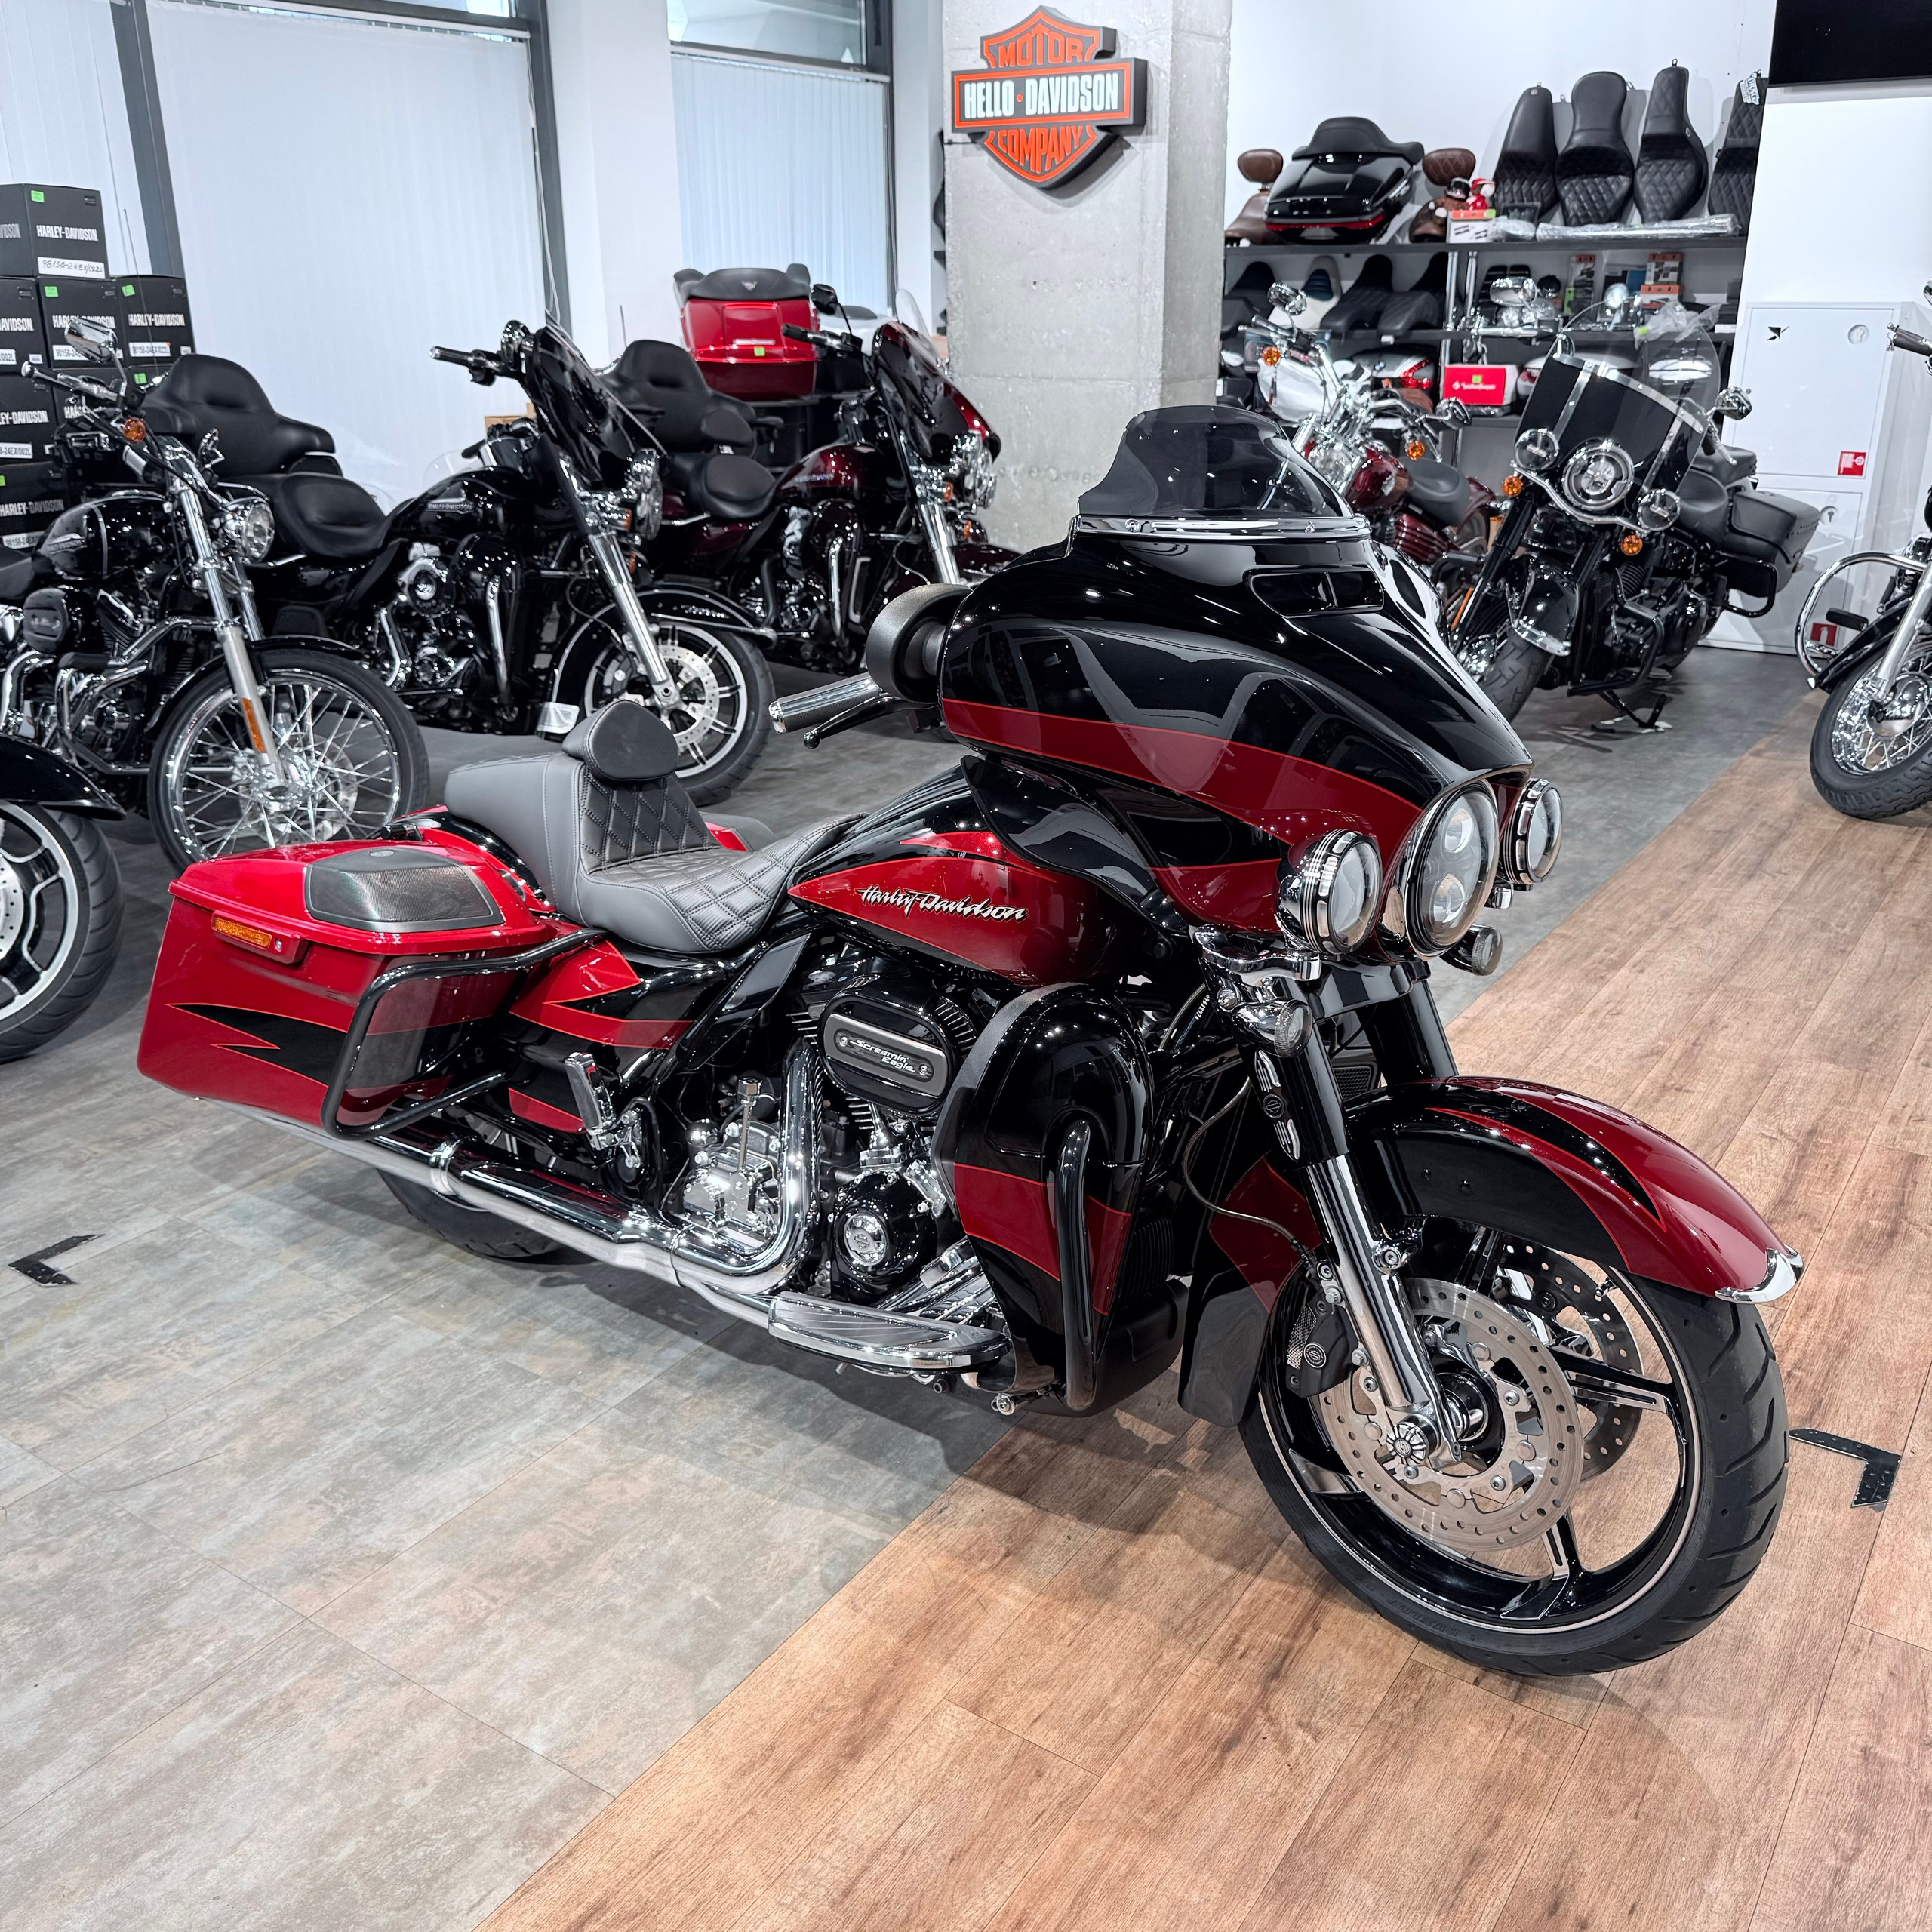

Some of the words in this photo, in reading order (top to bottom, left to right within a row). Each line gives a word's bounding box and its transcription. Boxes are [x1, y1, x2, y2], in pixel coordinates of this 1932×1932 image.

[998, 23, 1084, 68] MOTOR
[964, 80, 1014, 118] HELLO
[1025, 72, 1118, 115] DAVIDSON
[998, 125, 1083, 174] COMPANY
[36, 225, 98, 241] HARLEY-DAVIDSON
[128, 314, 185, 326] HARLEY-DAVIDSON
[856, 885, 1027, 921] Harley-Davidson
[881, 1056, 915, 1072] Eagle
